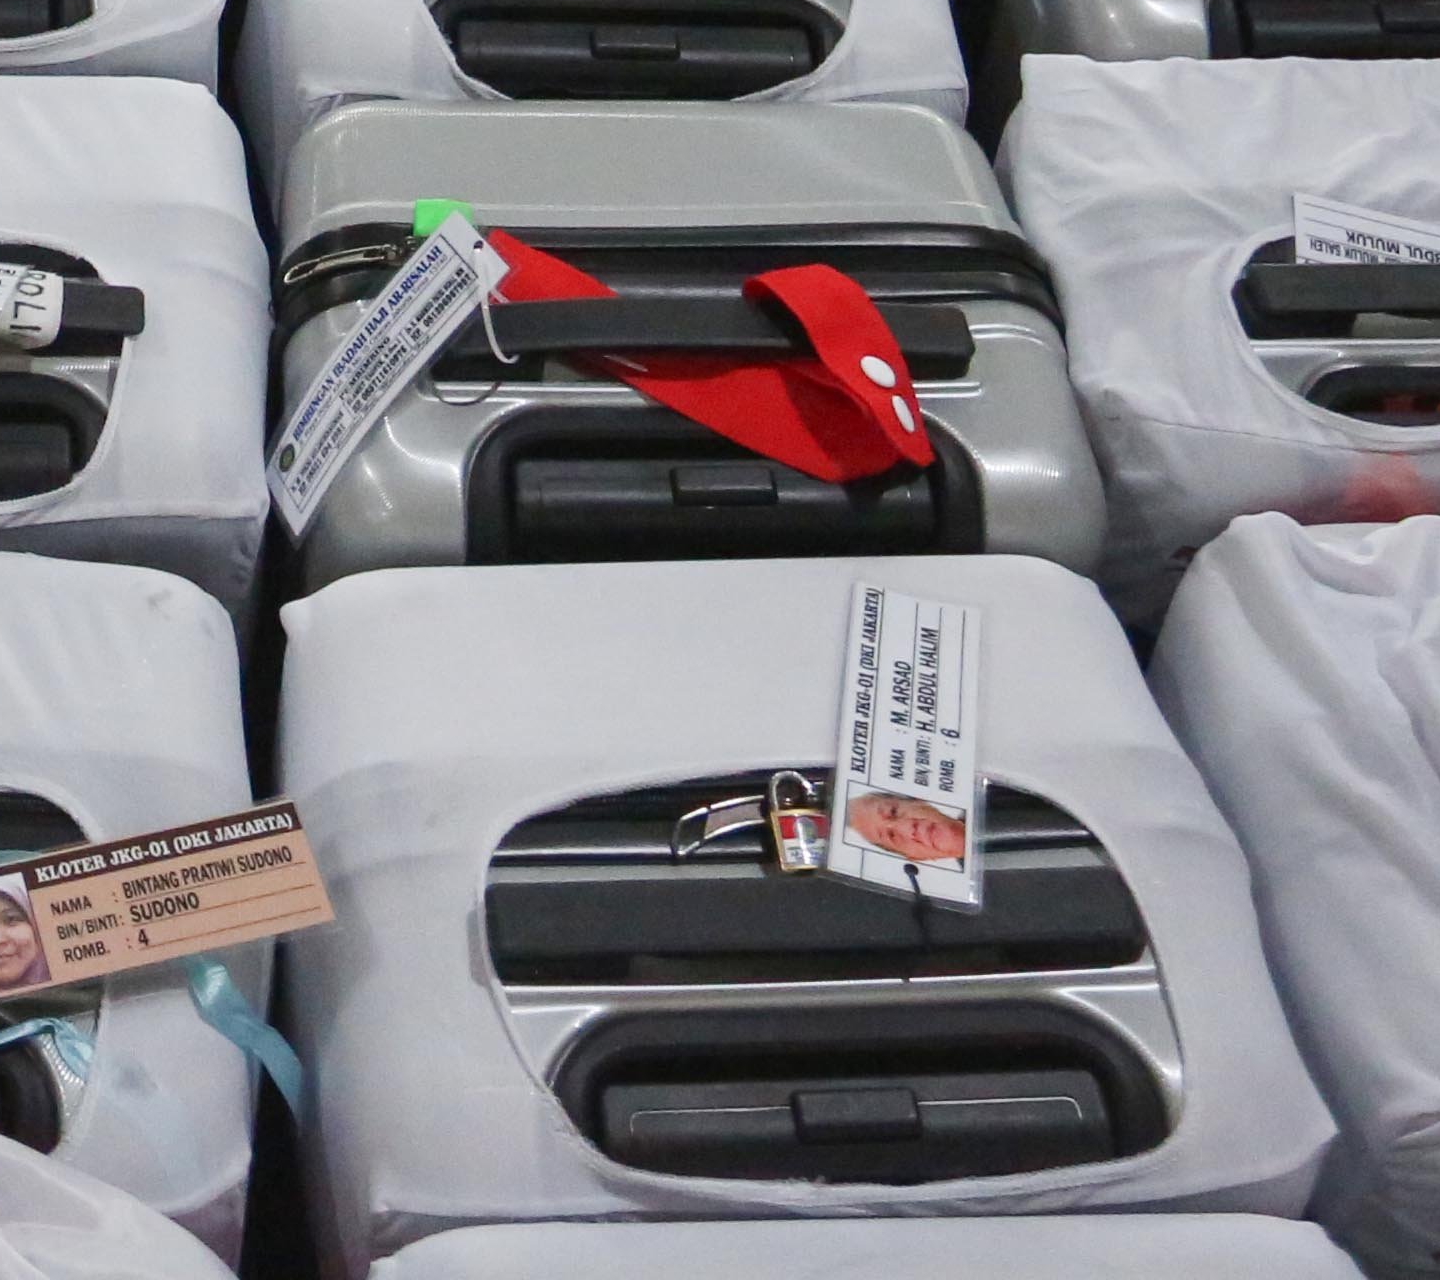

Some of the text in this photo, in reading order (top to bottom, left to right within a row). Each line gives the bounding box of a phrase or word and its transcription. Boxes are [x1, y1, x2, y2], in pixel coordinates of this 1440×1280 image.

[1344, 230, 1399, 254] MULUK
[289, 240, 443, 442] BIMBINGAN IBADAH HAJI AR-RISALAH
[850, 586, 884, 773] KLOTER JKG-01 (DKI JAKARTA)
[915, 625, 939, 733] H. ABDUL HALIM
[889, 659, 912, 781] NAMA M. ARSAD
[940, 726, 960, 739] 6
[34, 807, 295, 885] KLOTER JKG-01 (DKI JAKARTA)
[50, 844, 294, 917] NAMA BINTANG PRATIWI SUDONO
[127, 890, 201, 925] SUDONO
[62, 928, 151, 964] ROMB. 4
